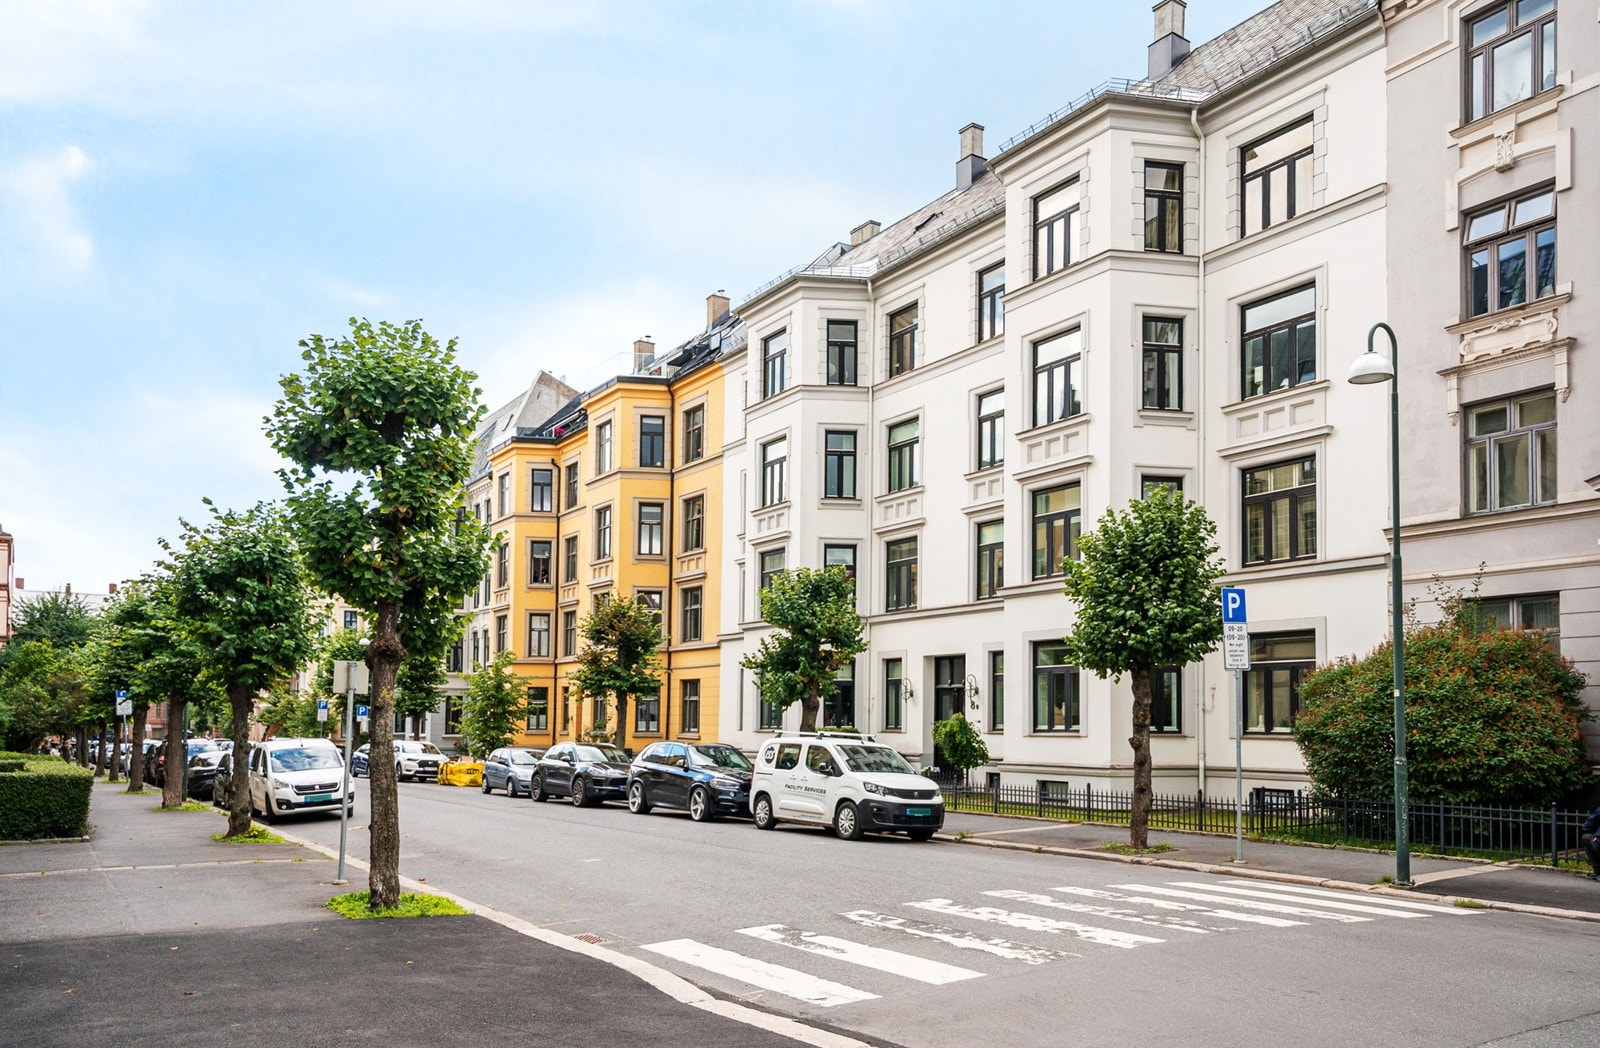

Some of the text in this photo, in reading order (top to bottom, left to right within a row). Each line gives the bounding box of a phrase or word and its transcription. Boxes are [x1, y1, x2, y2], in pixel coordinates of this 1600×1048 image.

[1227, 592, 1241, 619] P
[320, 701, 326, 709] P
[359, 706, 366, 715] P
[784, 783, 827, 795] FACILITY SERVICES
